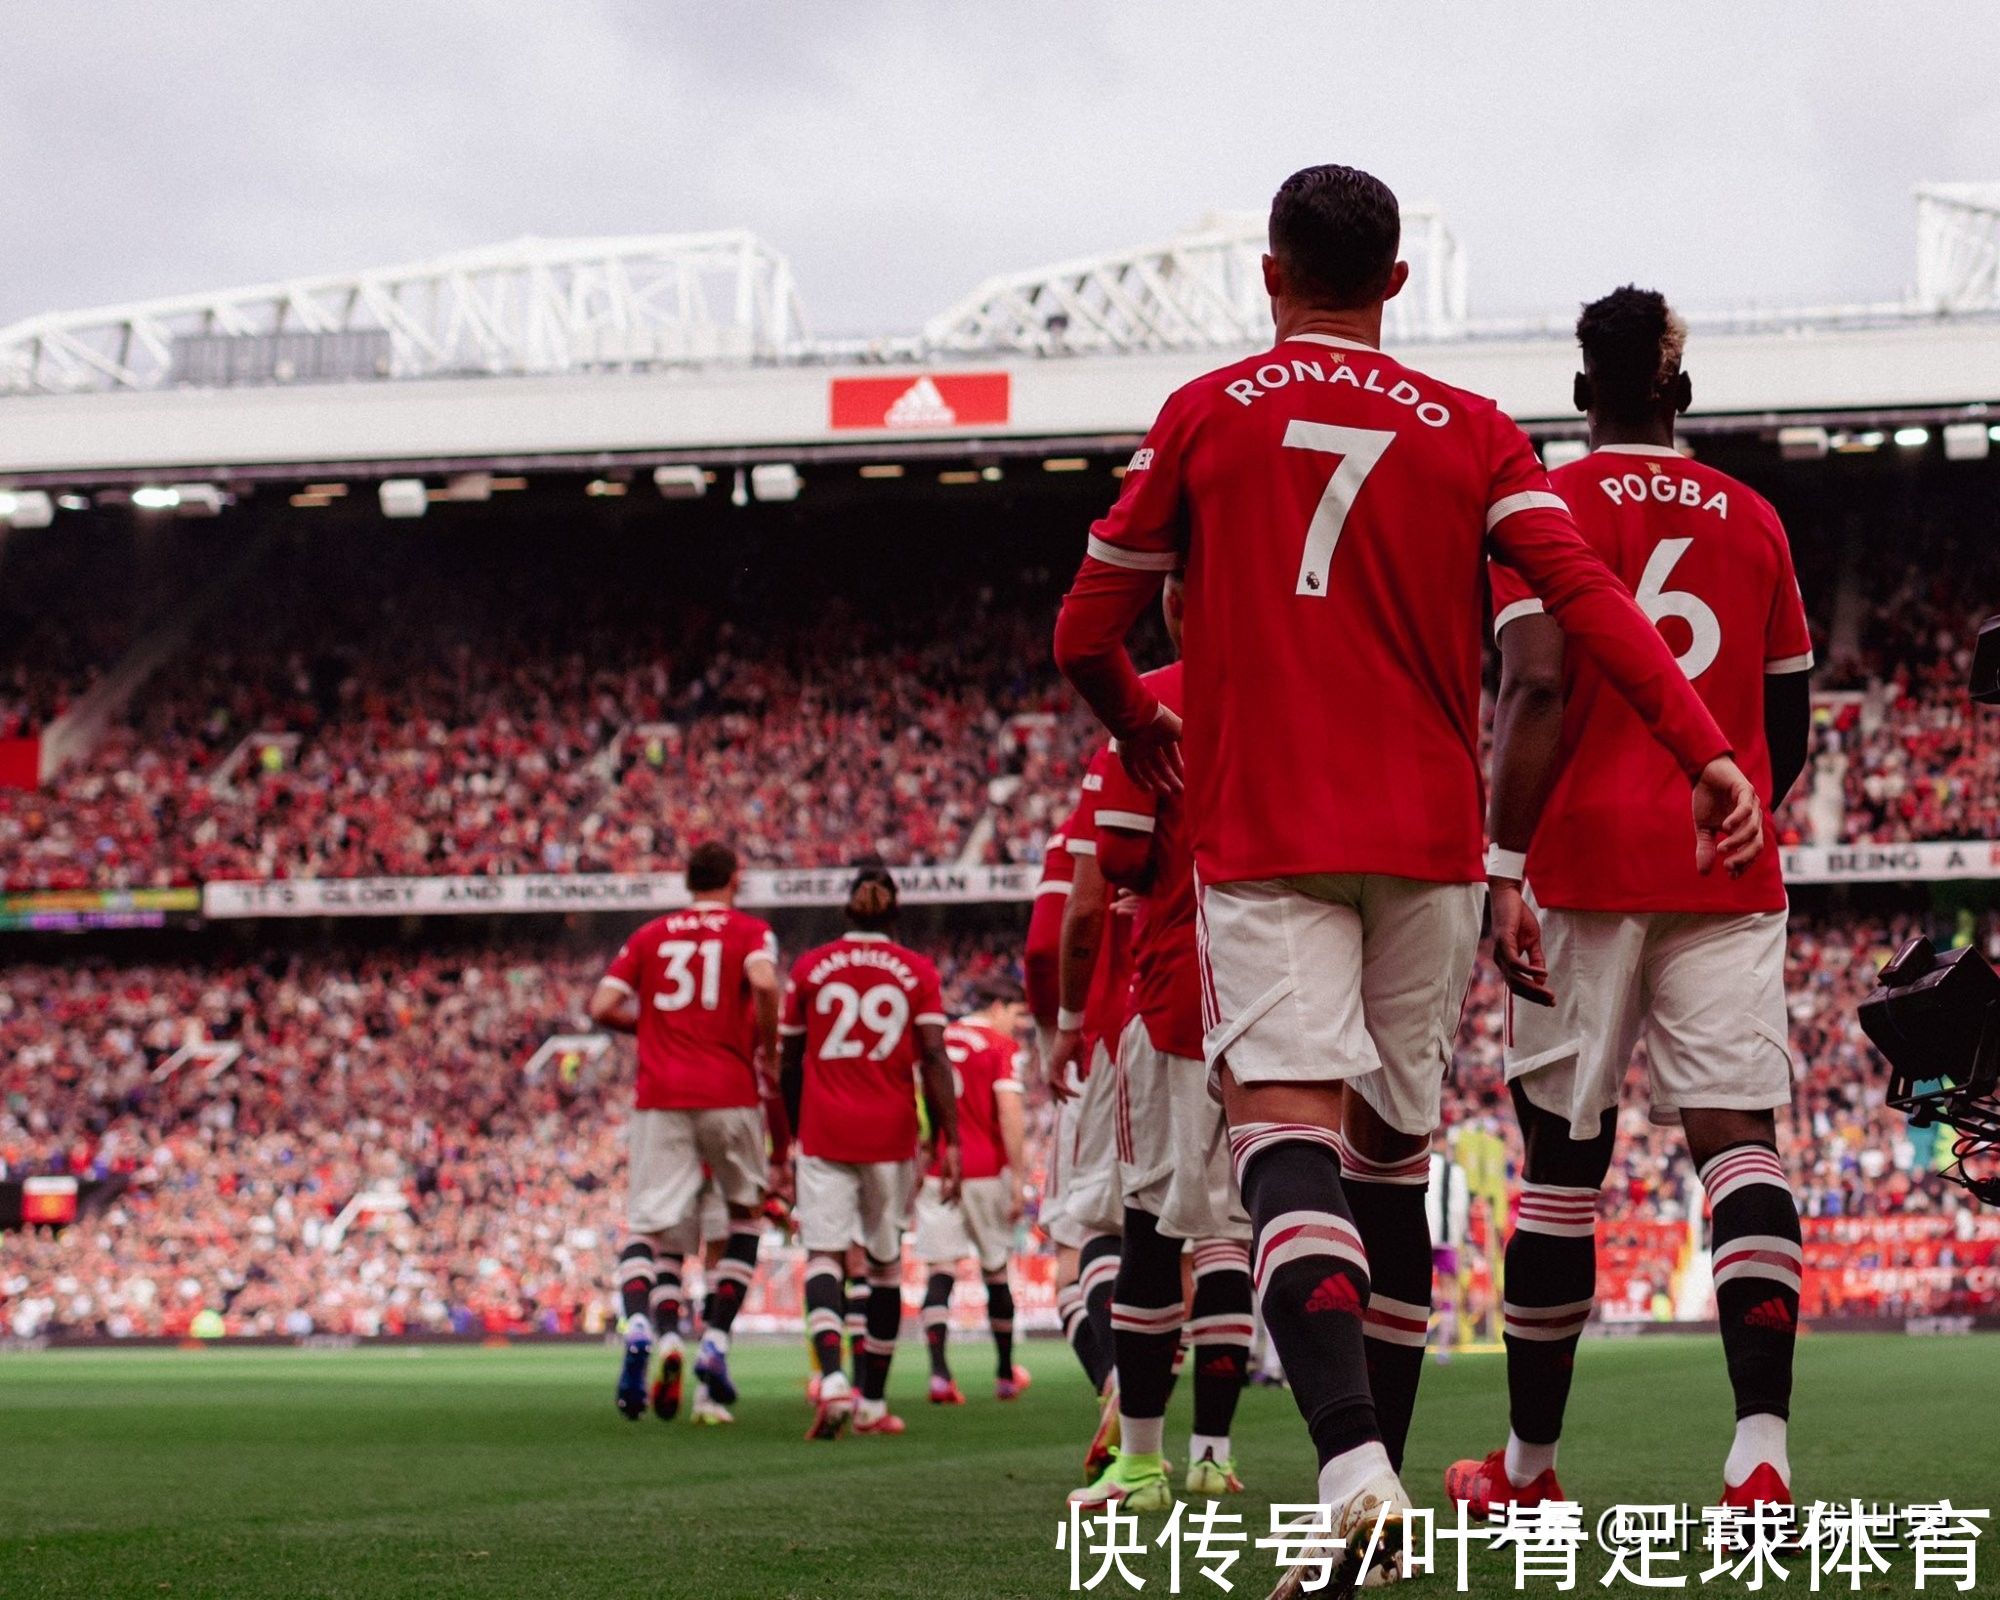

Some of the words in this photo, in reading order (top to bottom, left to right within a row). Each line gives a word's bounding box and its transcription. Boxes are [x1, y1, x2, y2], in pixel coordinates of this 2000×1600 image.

[1223, 360, 1452, 428] RONALDO
[1281, 419, 1397, 598] 7
[1599, 473, 1729, 520] POGBA
[1634, 537, 1722, 681] 6
[1827, 851, 1921, 872] BEING
[1947, 849, 1966, 869] A
[653, 939, 723, 1012] 31
[815, 982, 910, 1061] 29
